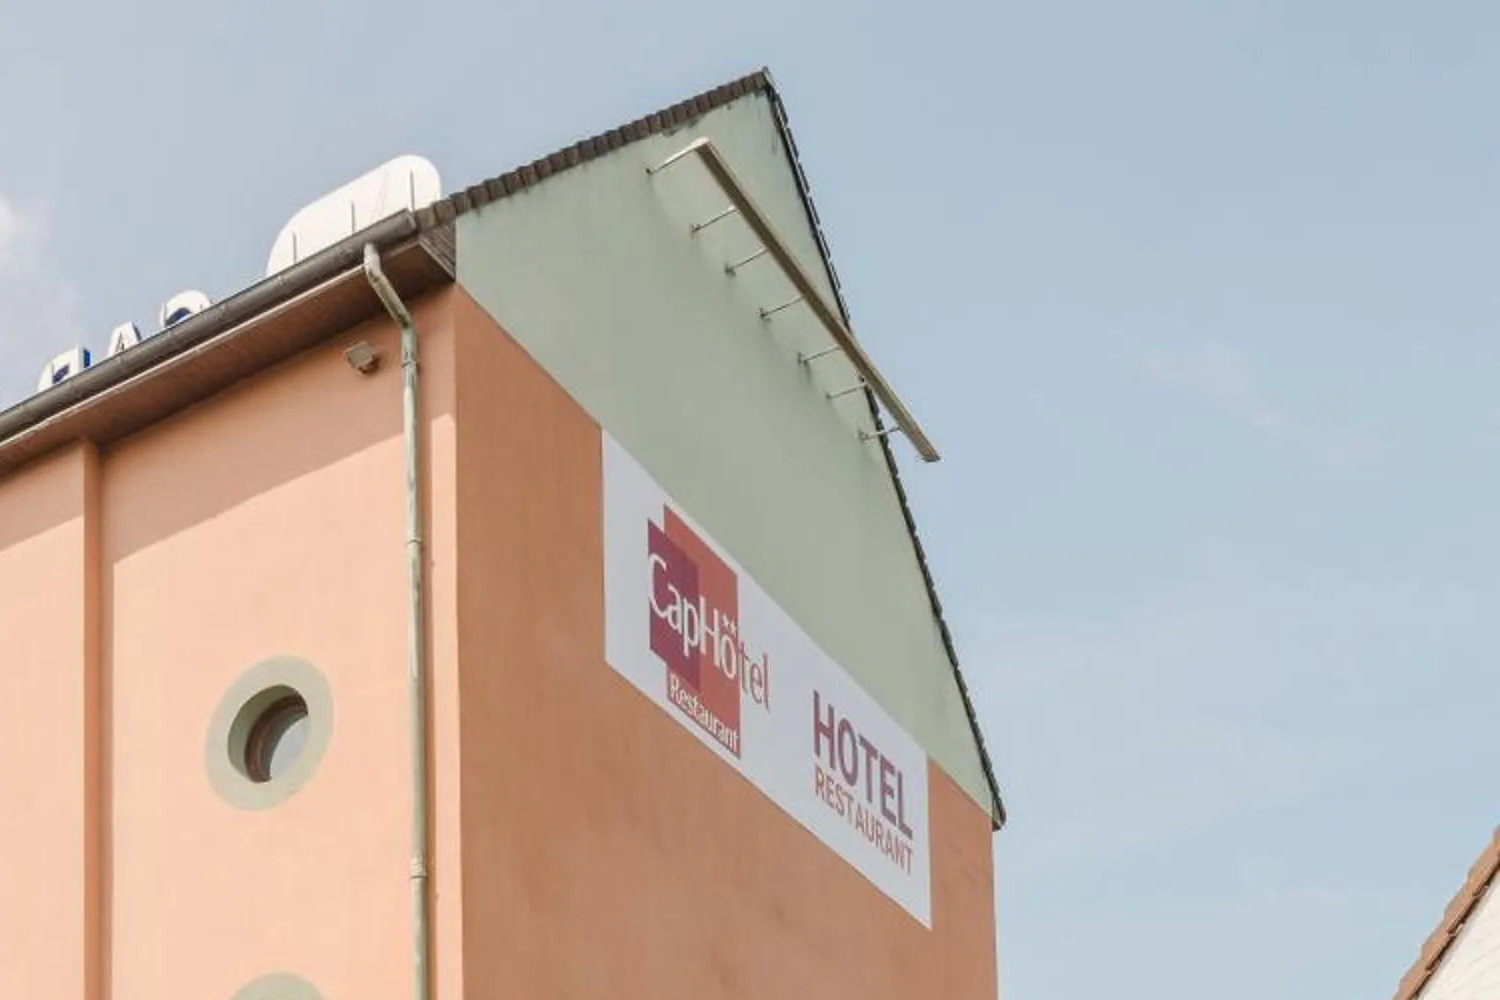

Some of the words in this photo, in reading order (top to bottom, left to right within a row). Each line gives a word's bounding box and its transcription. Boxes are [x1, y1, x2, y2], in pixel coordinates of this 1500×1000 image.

[669, 673, 739, 751] Restaurant
[813, 689, 913, 840] HOTEL
[815, 764, 913, 875] RESTAURANT
